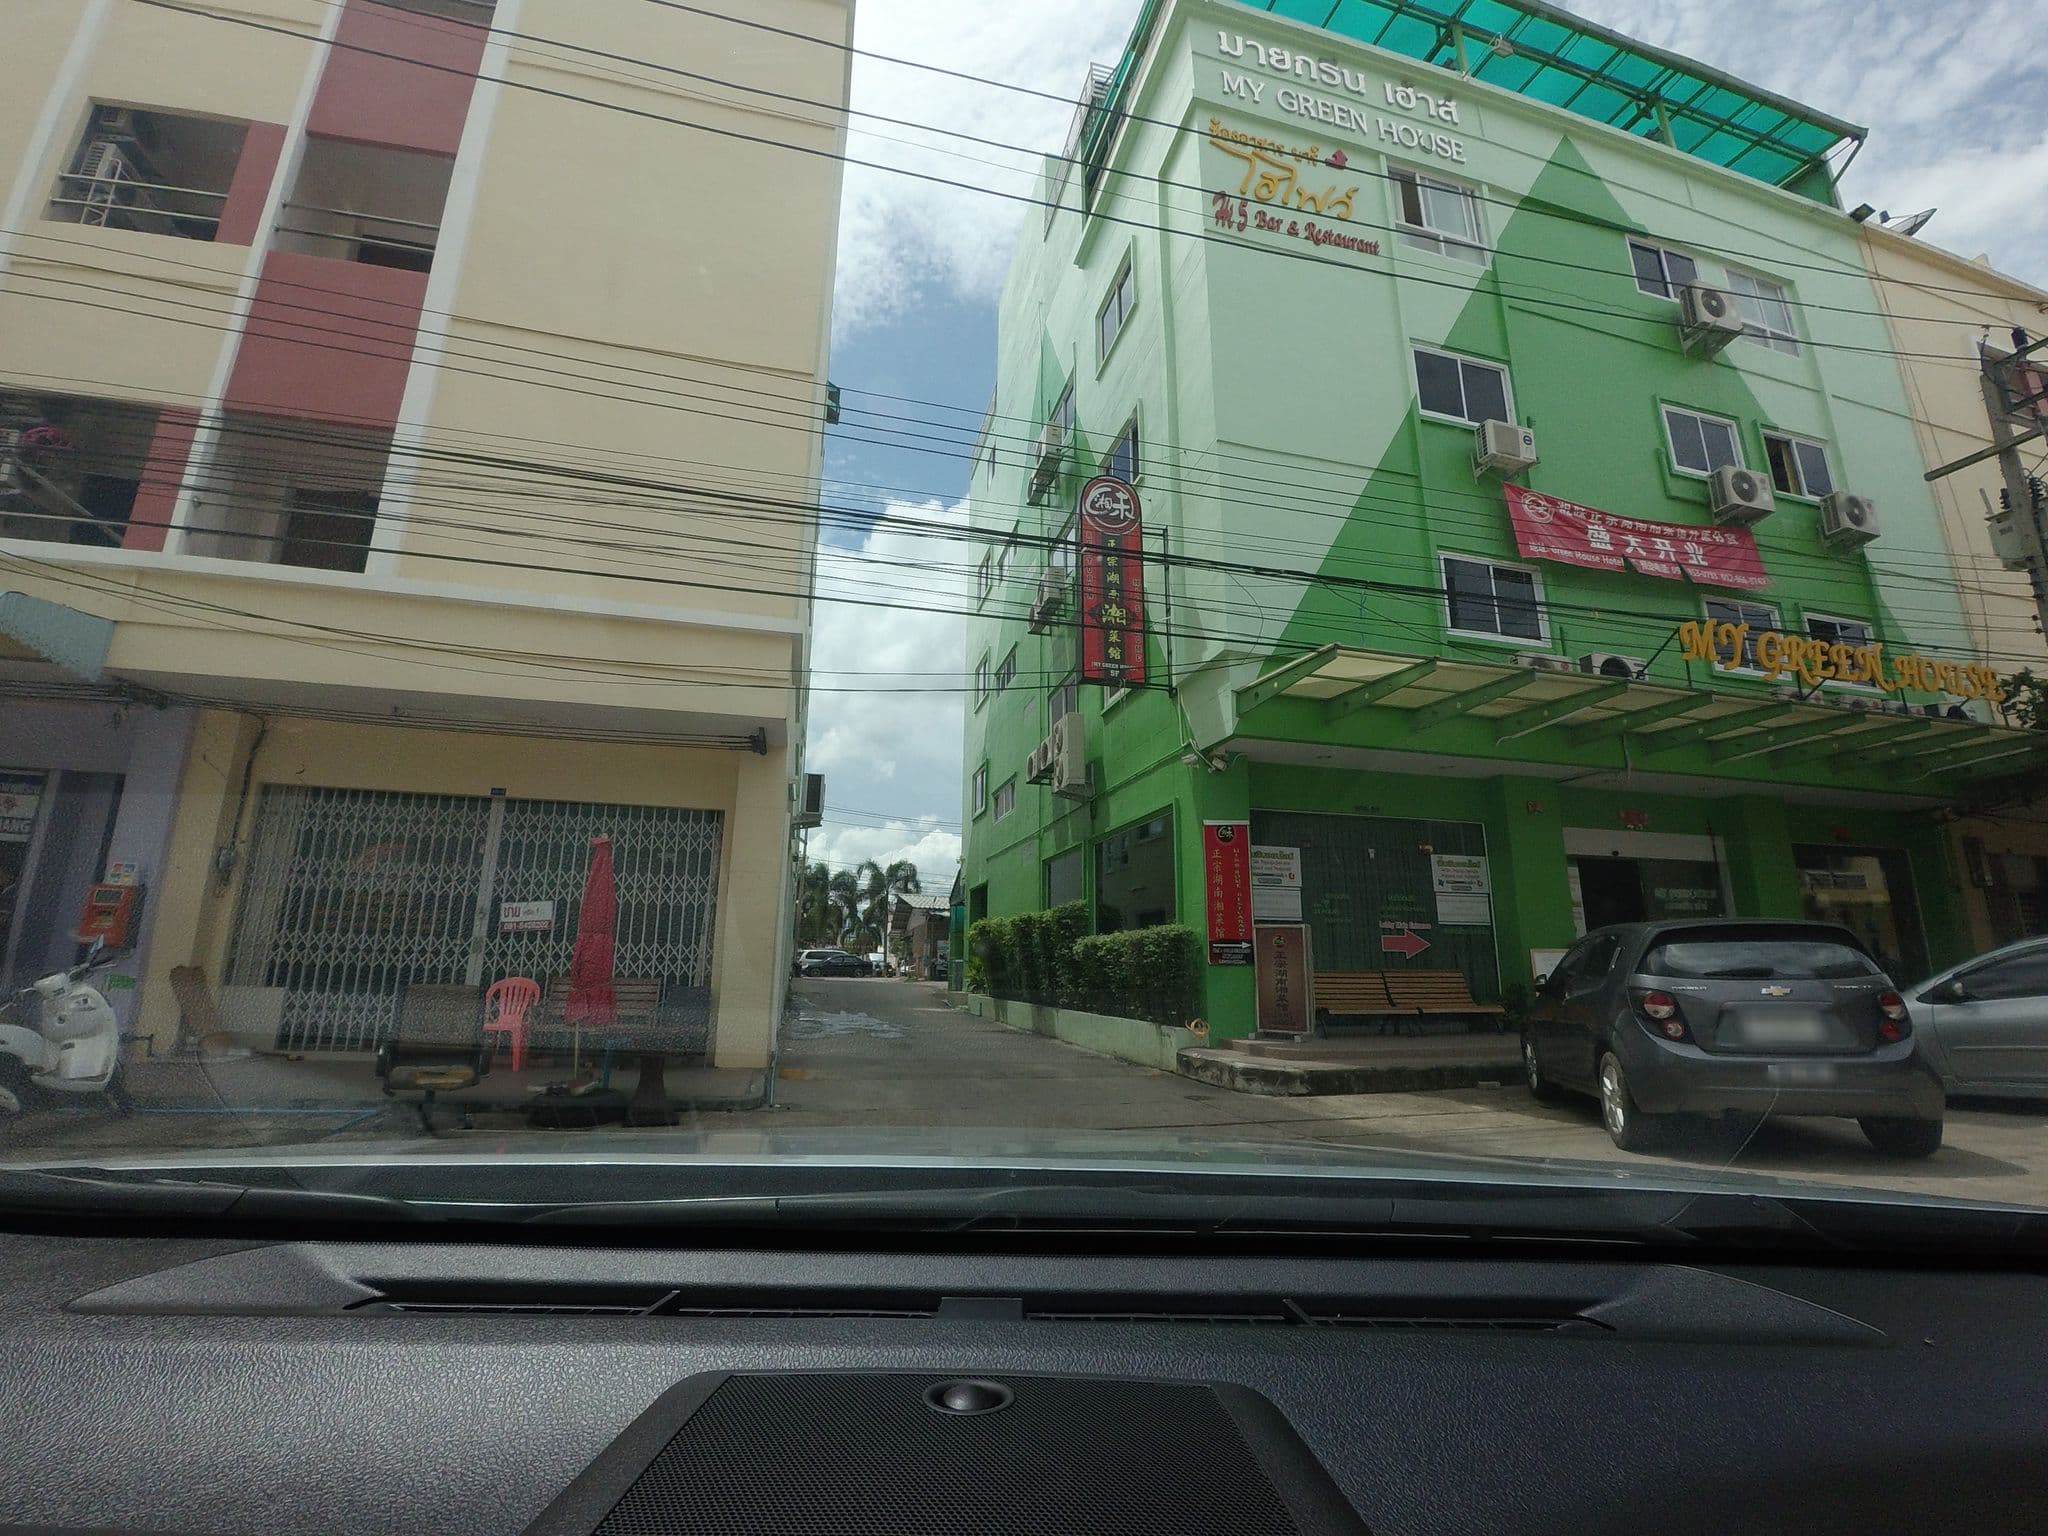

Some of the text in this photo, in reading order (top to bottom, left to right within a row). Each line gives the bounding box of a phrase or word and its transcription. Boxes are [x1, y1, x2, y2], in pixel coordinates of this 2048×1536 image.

[1221, 71, 1466, 164] MY GREEN HOUSE
[1255, 210, 1283, 233] Bar
[1287, 220, 1299, 236] &
[1304, 221, 1380, 256] Restaurant
[1586, 525, 1708, 566] 盛大开业
[1679, 618, 2006, 701] MY GREEN HOUSE
